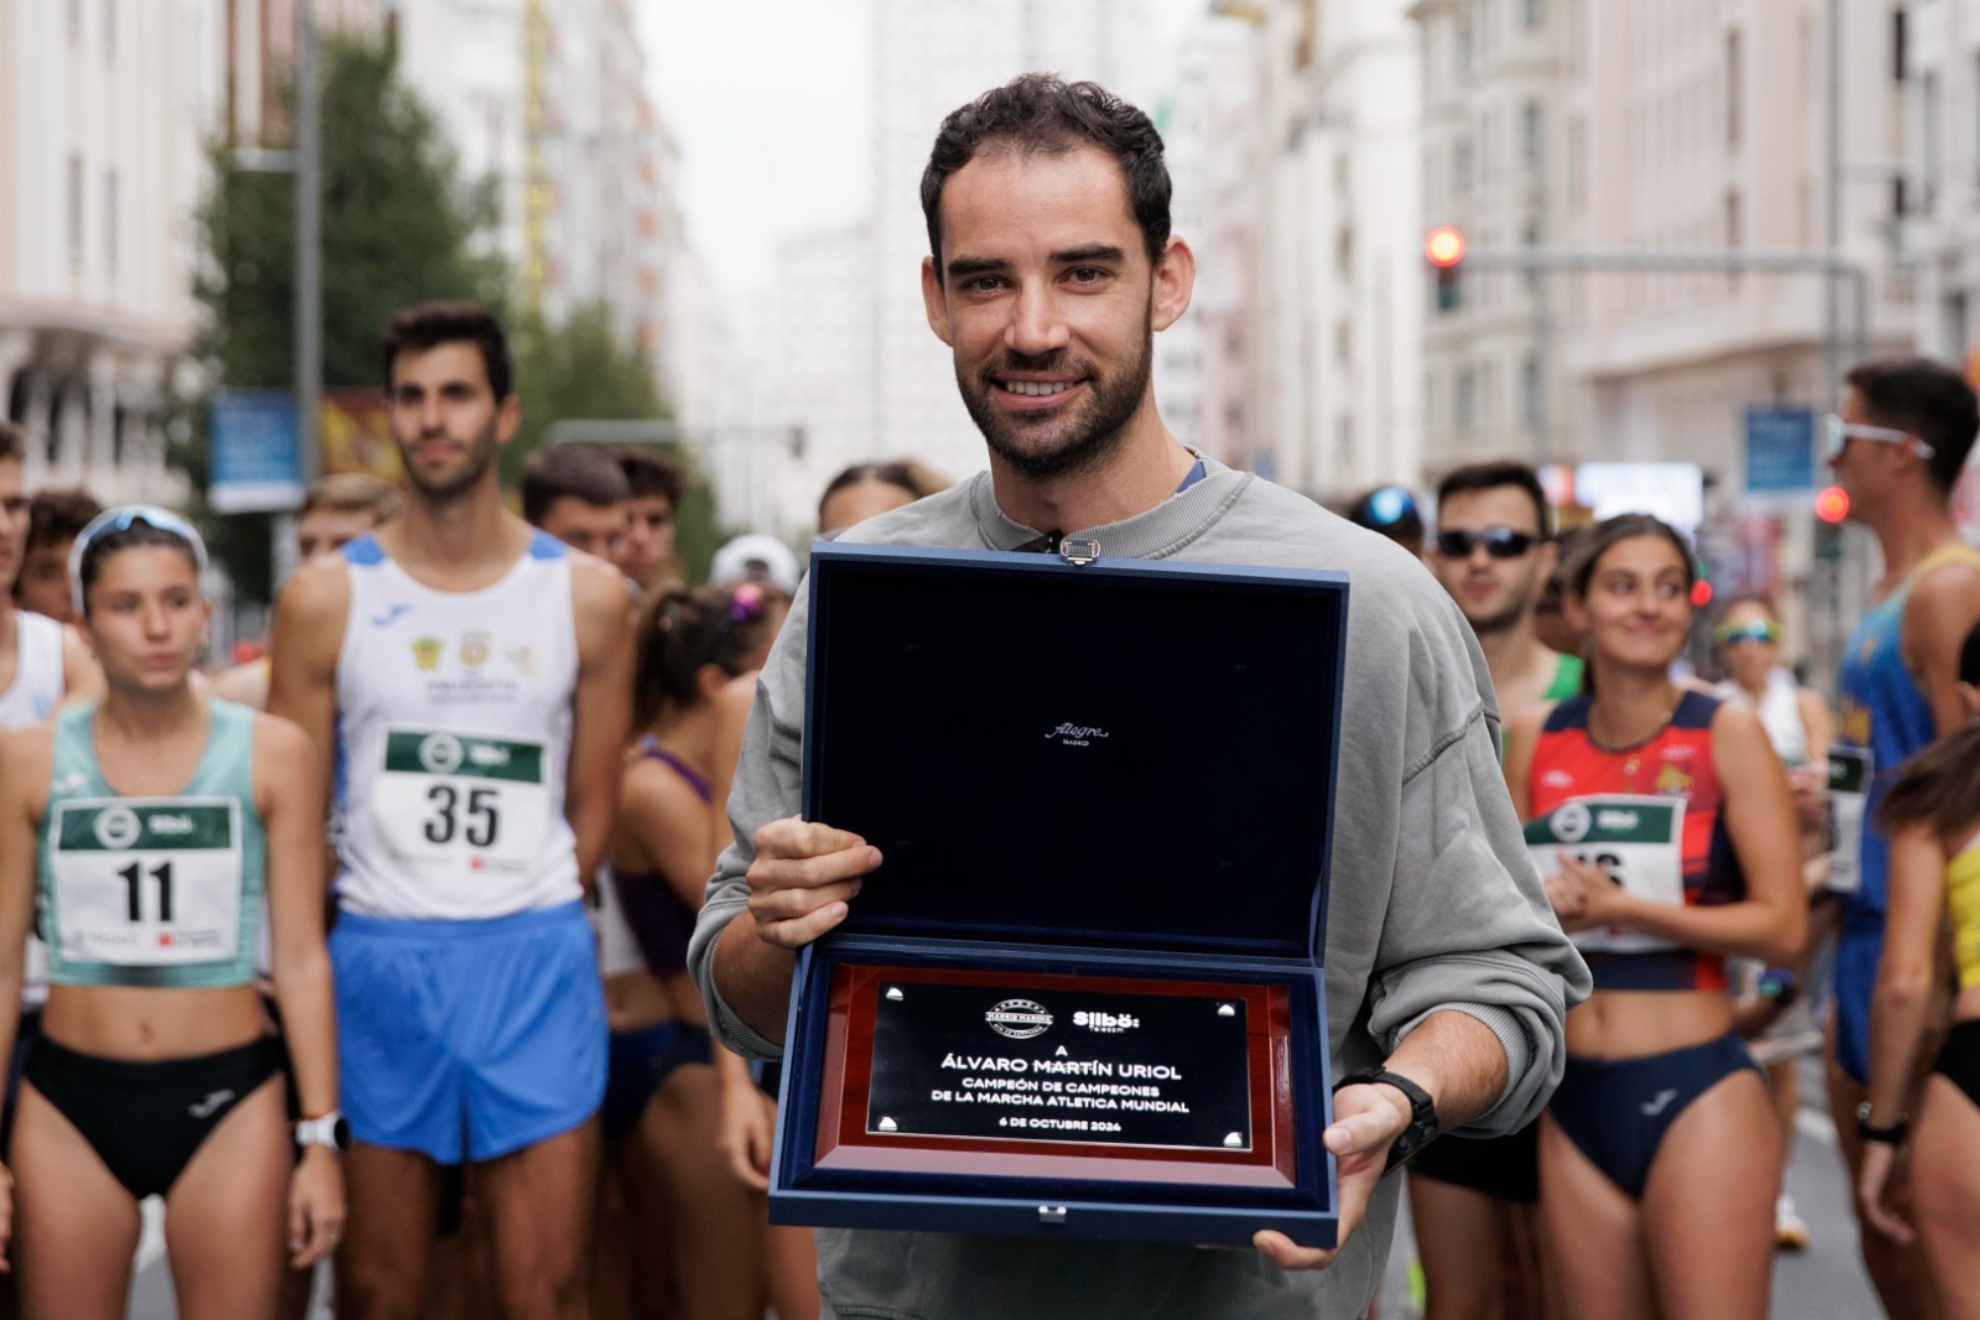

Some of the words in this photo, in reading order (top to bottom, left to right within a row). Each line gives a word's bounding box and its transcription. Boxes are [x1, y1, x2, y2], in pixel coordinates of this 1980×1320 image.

[1044, 721, 1109, 739] Alegre
[424, 785, 498, 848] 35
[117, 862, 171, 922] 11
[1055, 1045, 1068, 1057] A
[941, 1052, 1028, 1072] ÁLVARO
[1032, 1059, 1113, 1077] MARTÍN
[1118, 1063, 1182, 1080] URIOL
[962, 1077, 1039, 1092] CAMPEÓN
[1042, 1080, 1062, 1093] DE
[1065, 1081, 1160, 1097] CAMPEONES
[931, 1089, 952, 1101] DE
[954, 1091, 974, 1102] LA
[977, 1092, 1043, 1106] MARCHA
[1046, 1096, 1118, 1109] ATLETICA
[1121, 1099, 1190, 1113] MUNDIAL
[999, 1117, 1008, 1127] 6
[1009, 1117, 1027, 1128] DE
[1029, 1118, 1088, 1131] OCTUBRE
[1090, 1121, 1122, 1132] 2024
